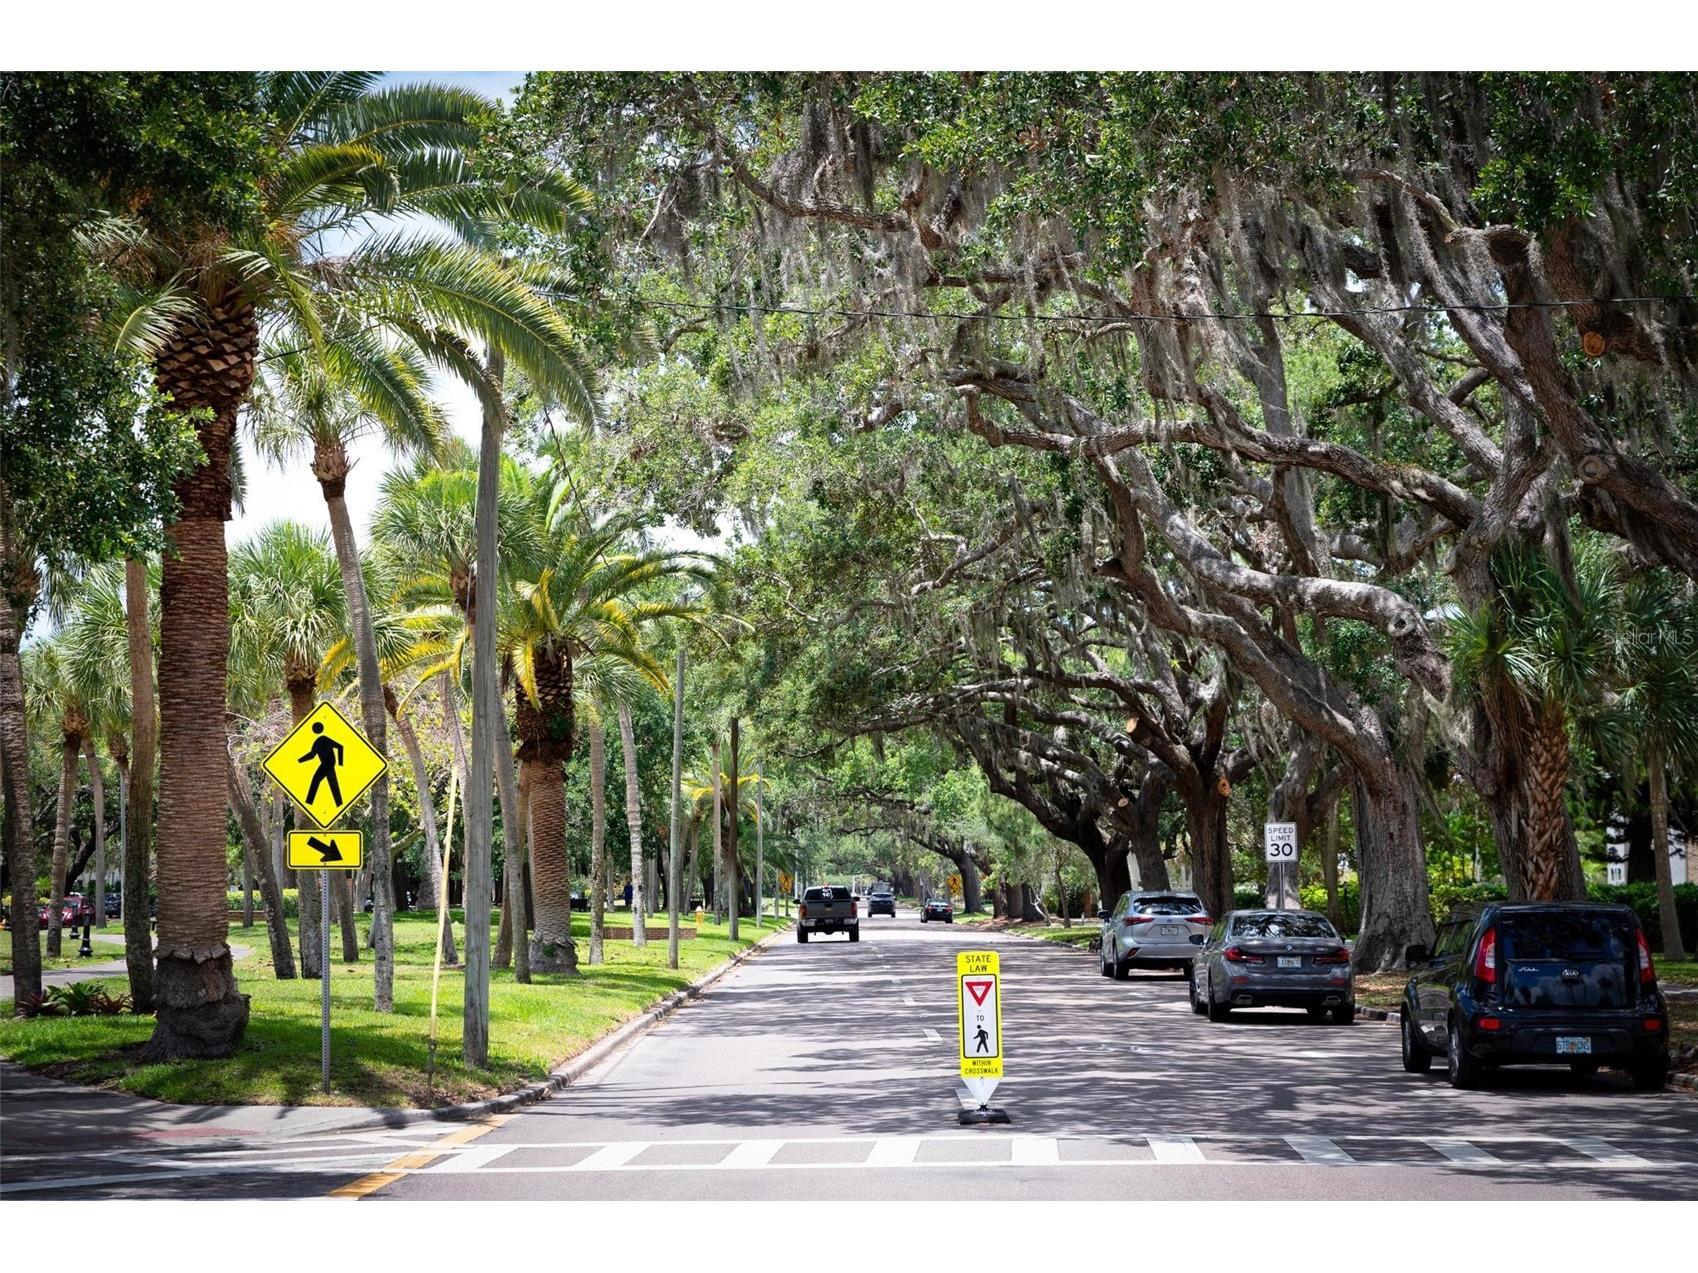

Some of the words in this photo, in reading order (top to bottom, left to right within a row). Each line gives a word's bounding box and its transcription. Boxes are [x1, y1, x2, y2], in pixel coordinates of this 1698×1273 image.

[1270, 834, 1291, 842] LIMIT
[1270, 843, 1293, 857] 30
[965, 954, 992, 963] STATE
[969, 964, 988, 973] LAW
[976, 1014, 985, 1022] TO
[964, 1067, 999, 1075] CROSSWALK
